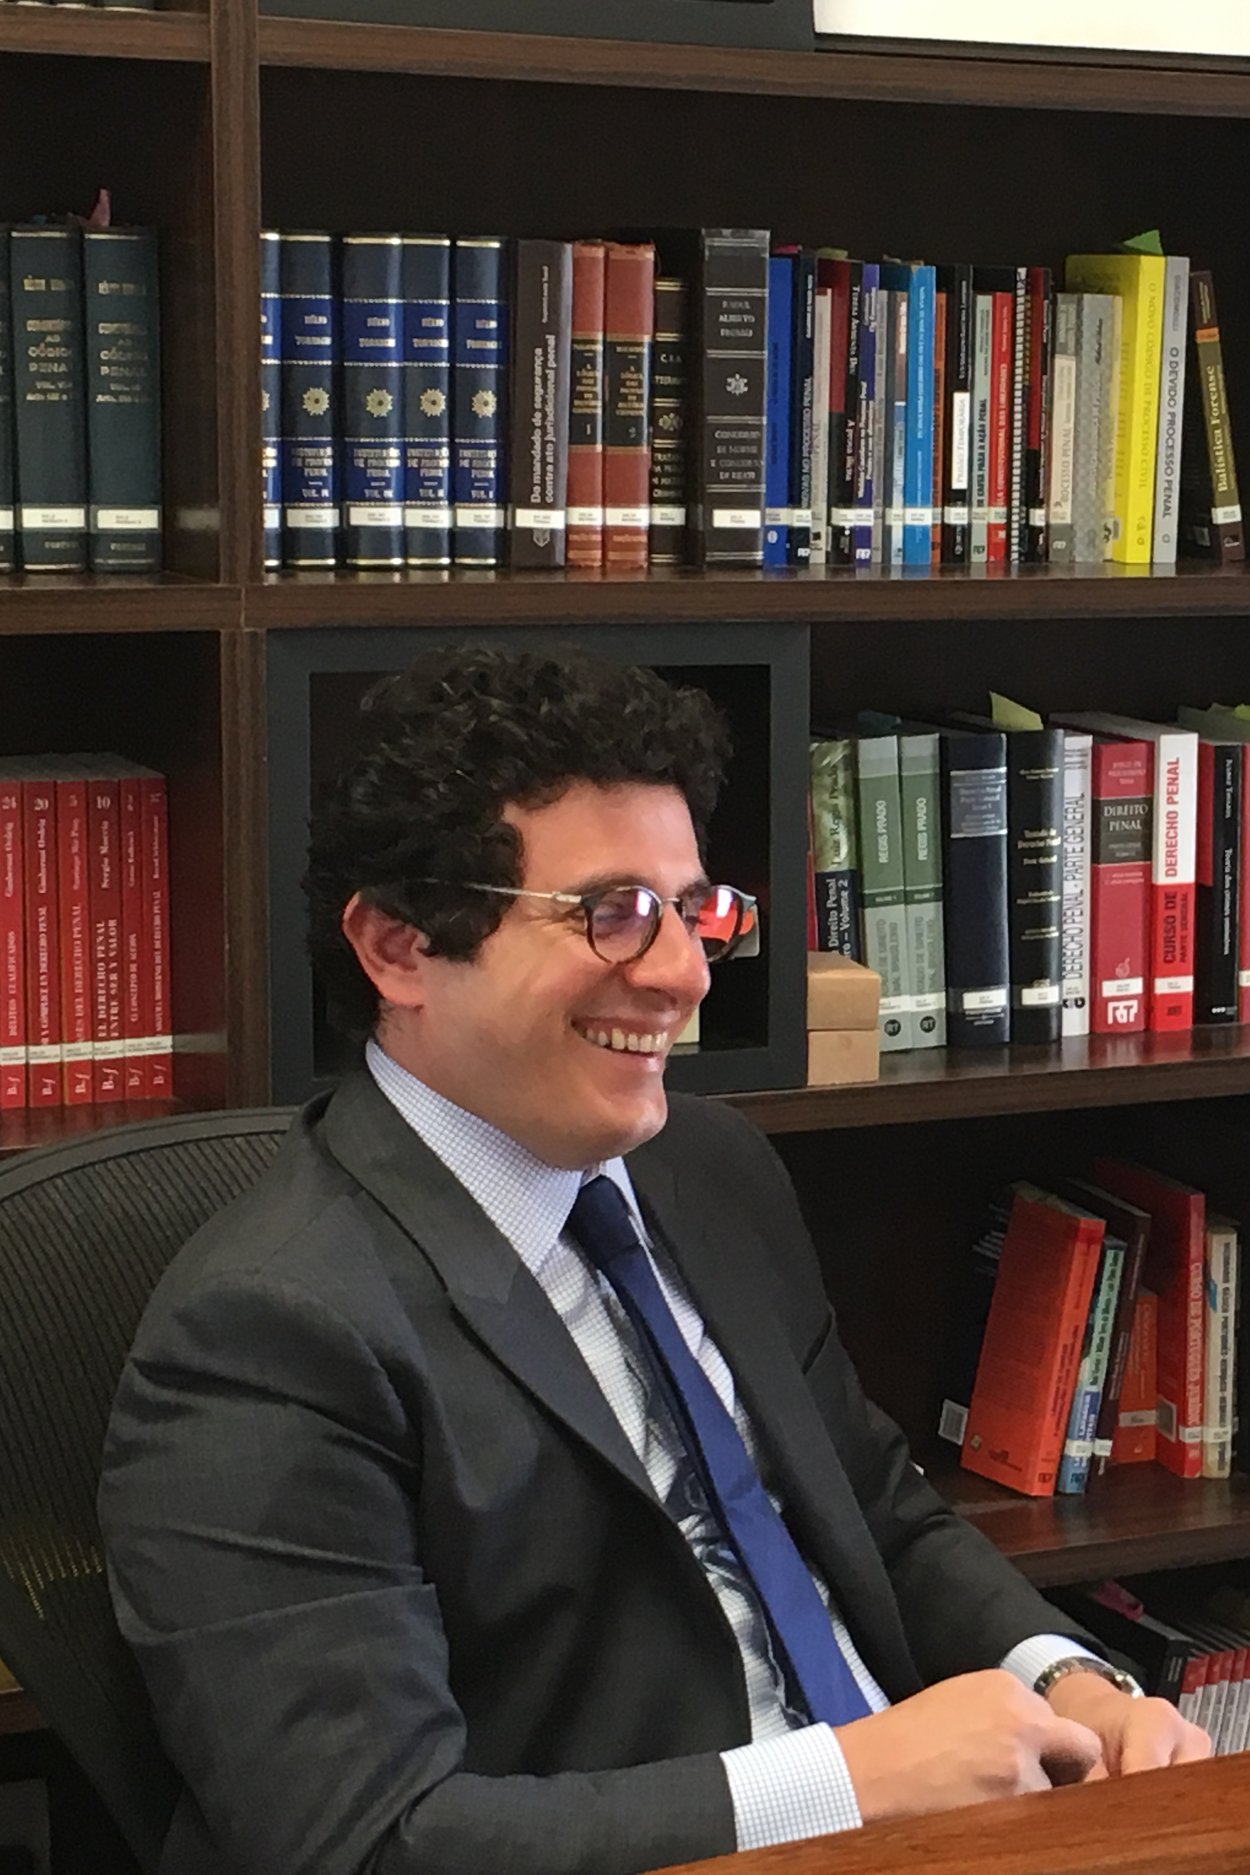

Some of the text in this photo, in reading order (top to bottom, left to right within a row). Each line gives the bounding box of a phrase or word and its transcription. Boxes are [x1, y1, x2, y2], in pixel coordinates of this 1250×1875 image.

[545, 334, 557, 367] penal
[544, 369, 556, 442] jurisdicional
[1139, 399, 1152, 456] PROCESSO
[1203, 364, 1228, 492] Balística Forense
[530, 427, 542, 484] mandado
[546, 442, 554, 463] ato
[1163, 346, 1179, 519] O DEVIDO PROCESSO PENAL
[531, 485, 541, 503] Do
[545, 464, 554, 503] contra
[1138, 458, 1149, 488] CIVIL
[96, 795, 111, 809] 10
[1103, 803, 1149, 817] DIREITO
[1108, 819, 1142, 832] PENAL
[1164, 757, 1180, 878] DERECHO PENAL
[876, 799, 889, 864] REGIS PRADO
[916, 797, 929, 861] REGIS PRADO
[1062, 793, 1084, 980] DERECHO PENAL PARTE GENERAL
[1224, 847, 1233, 874] Teoria
[72, 904, 82, 939] PENAL
[826, 879, 839, 948] Direito Penal
[837, 879, 850, 931] Volume 2
[1162, 891, 1178, 965] CURSO DE
[108, 918, 118, 958] VALOR
[96, 920, 107, 1037] EL DERECHO PENAL
[110, 1001, 119, 1037] ENTRE
